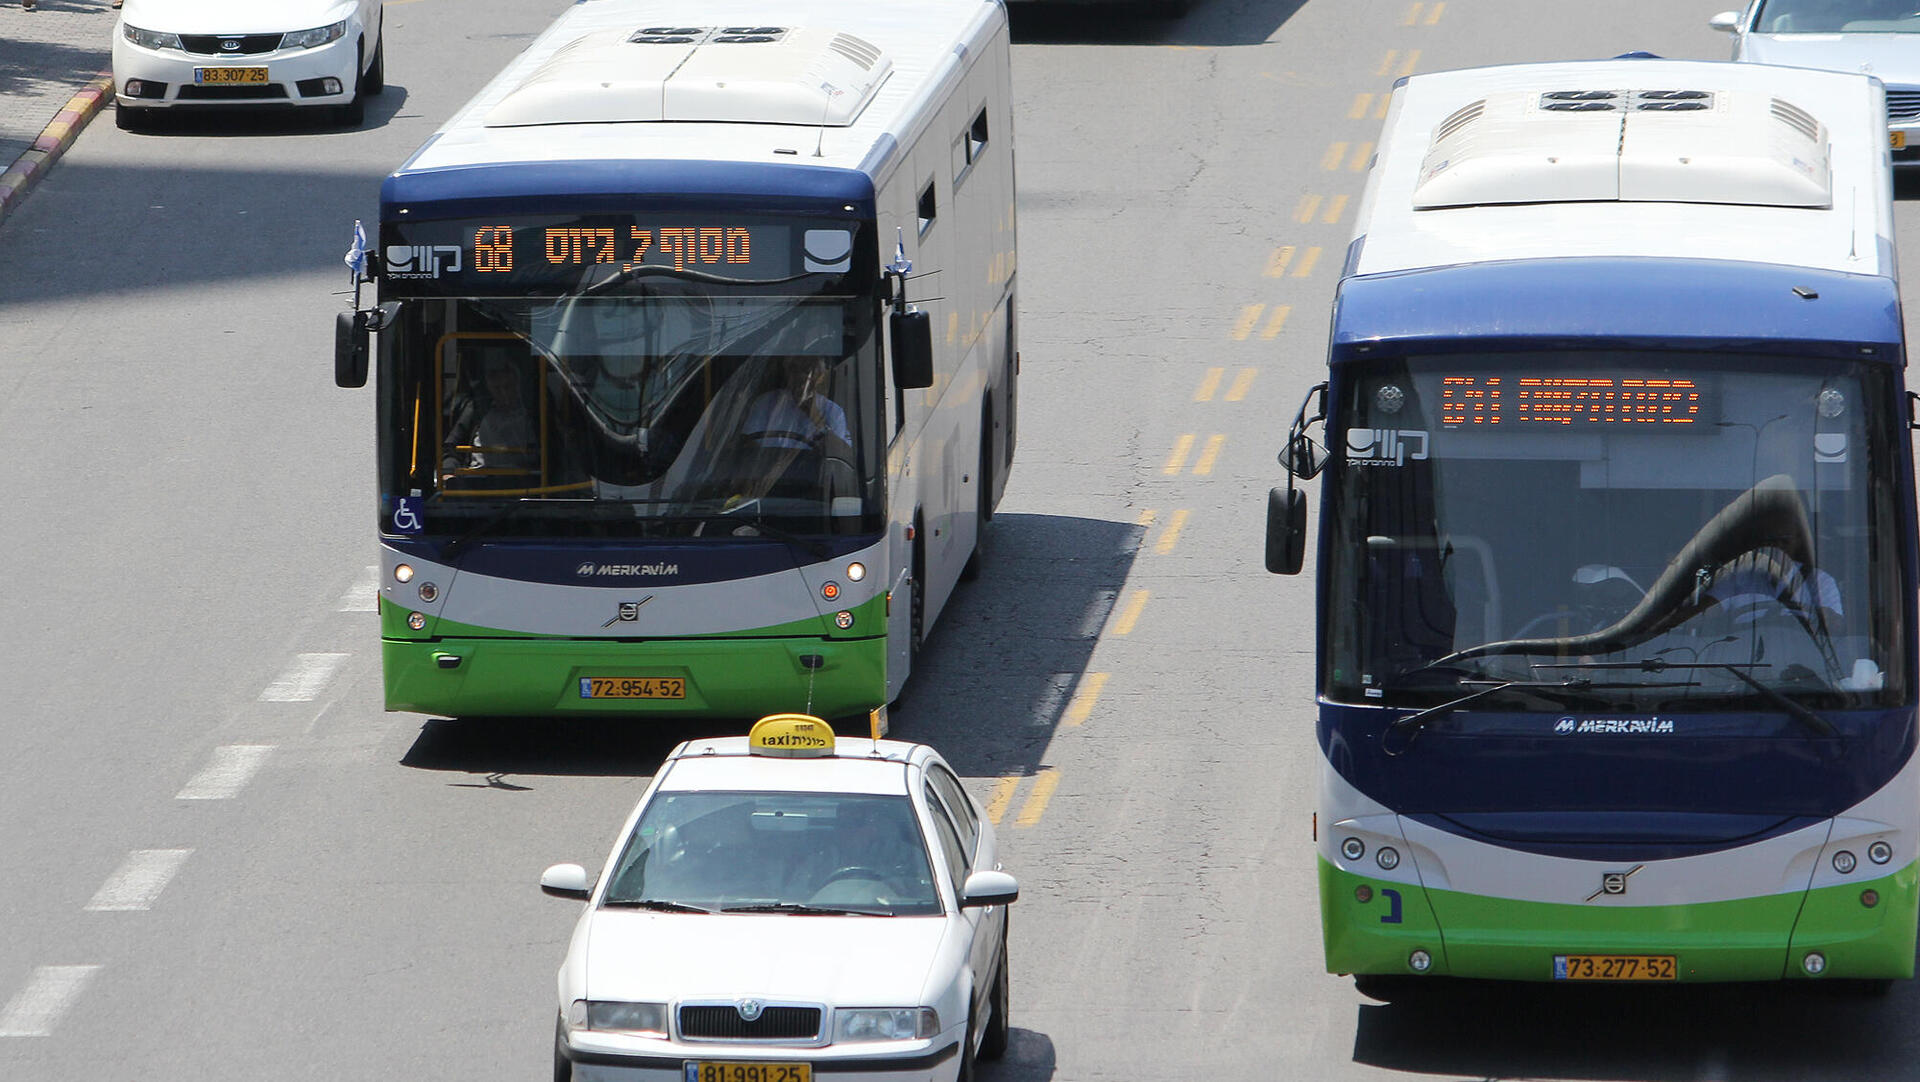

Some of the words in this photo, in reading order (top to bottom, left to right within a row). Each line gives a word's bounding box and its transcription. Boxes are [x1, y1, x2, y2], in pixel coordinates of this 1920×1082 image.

[474, 225, 513, 272] 68
[660, 227, 751, 272] מסוף
[762, 732, 789, 746] taxi
[791, 735, 826, 747] מונית
